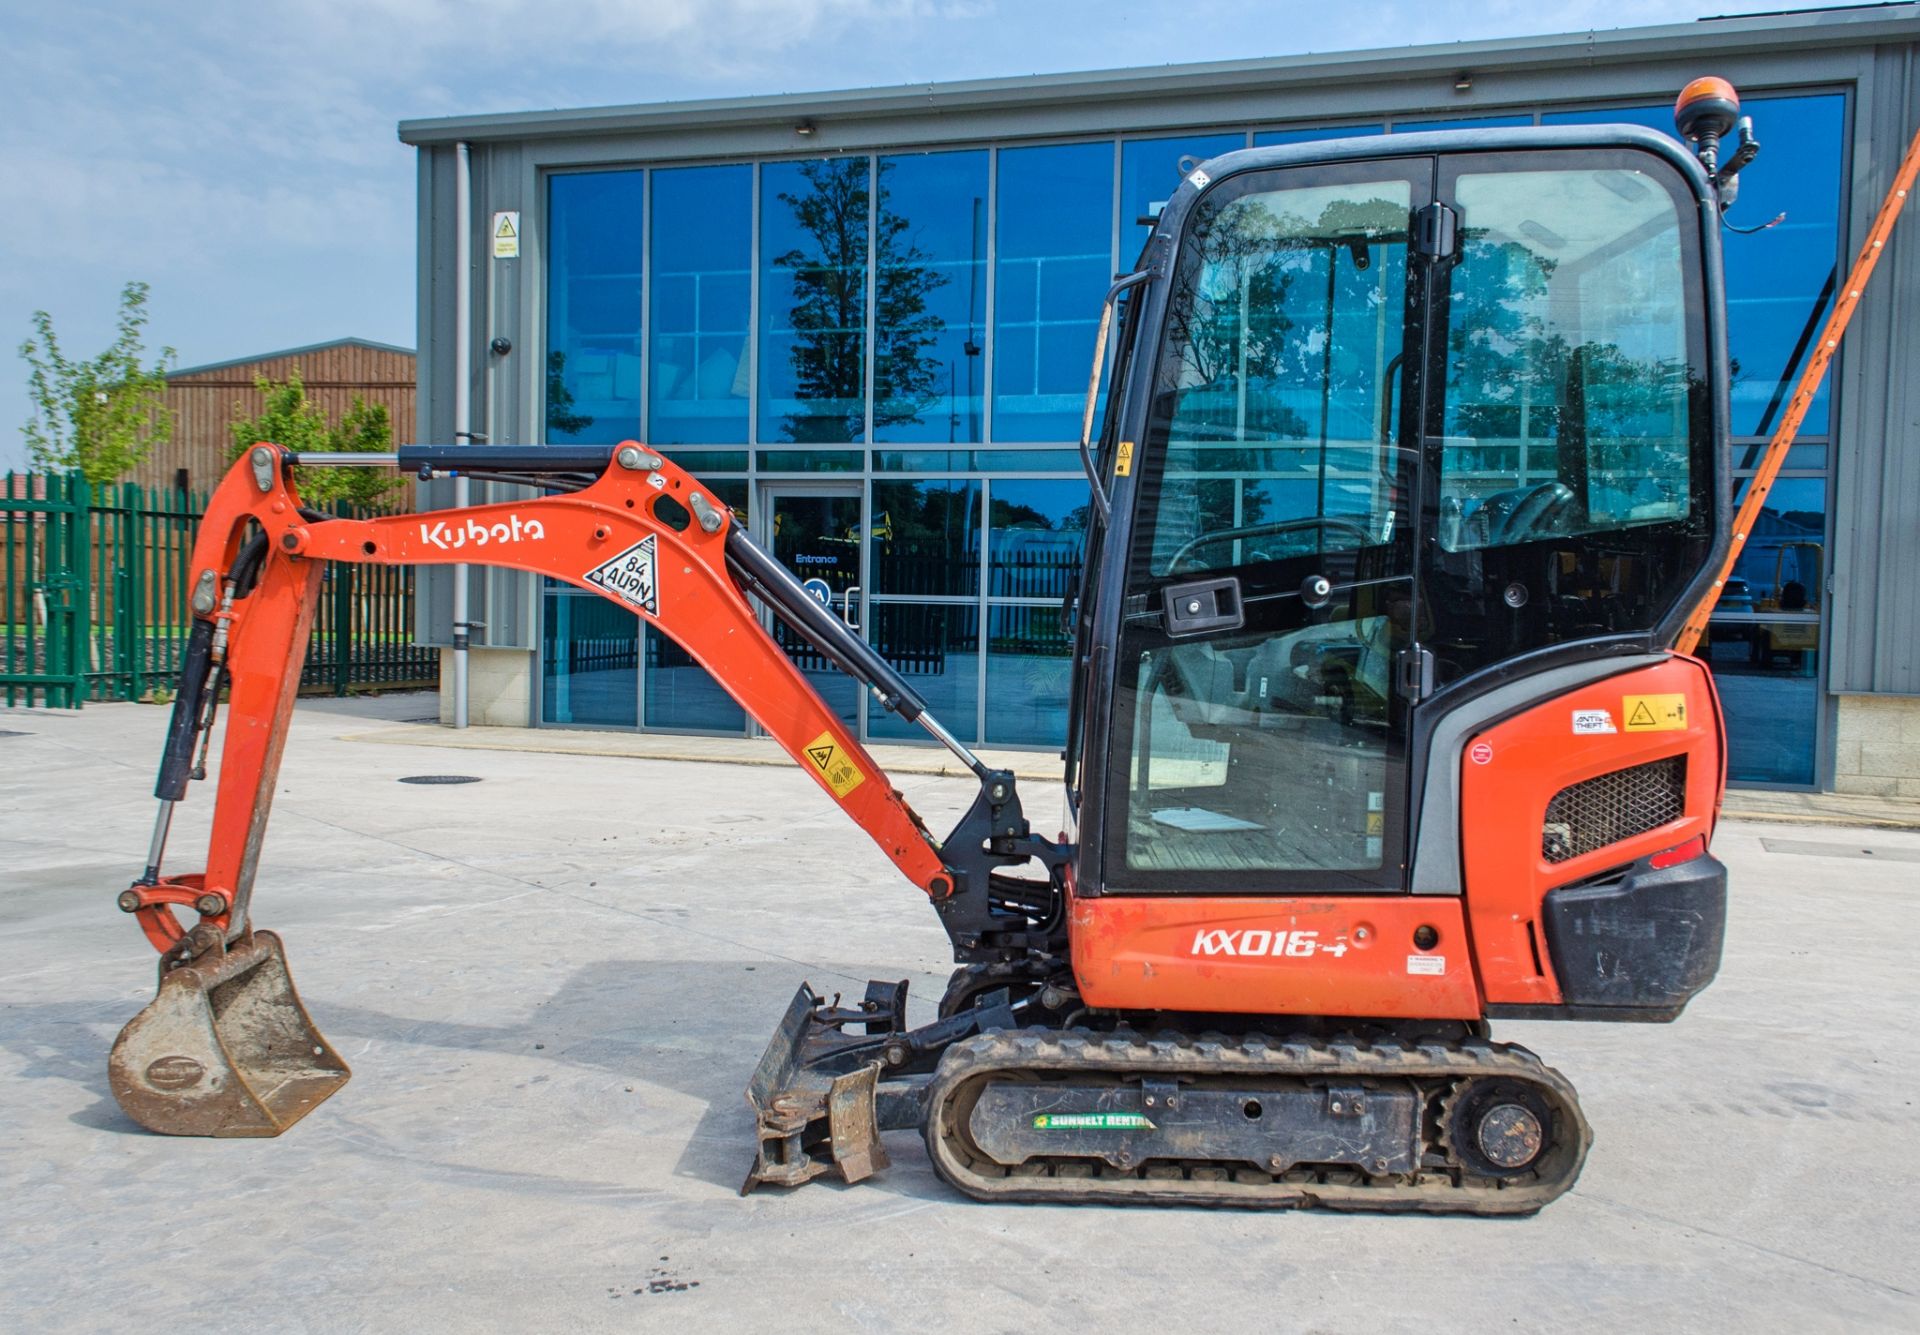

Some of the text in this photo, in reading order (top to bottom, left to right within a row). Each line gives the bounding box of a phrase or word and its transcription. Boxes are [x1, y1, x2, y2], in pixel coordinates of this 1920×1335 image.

[420, 514, 545, 550] Kubota
[626, 556, 648, 576] 84
[796, 554, 838, 564] Entrance
[607, 567, 651, 600] AU9N
[1051, 1116, 1104, 1126] SUNBELT
